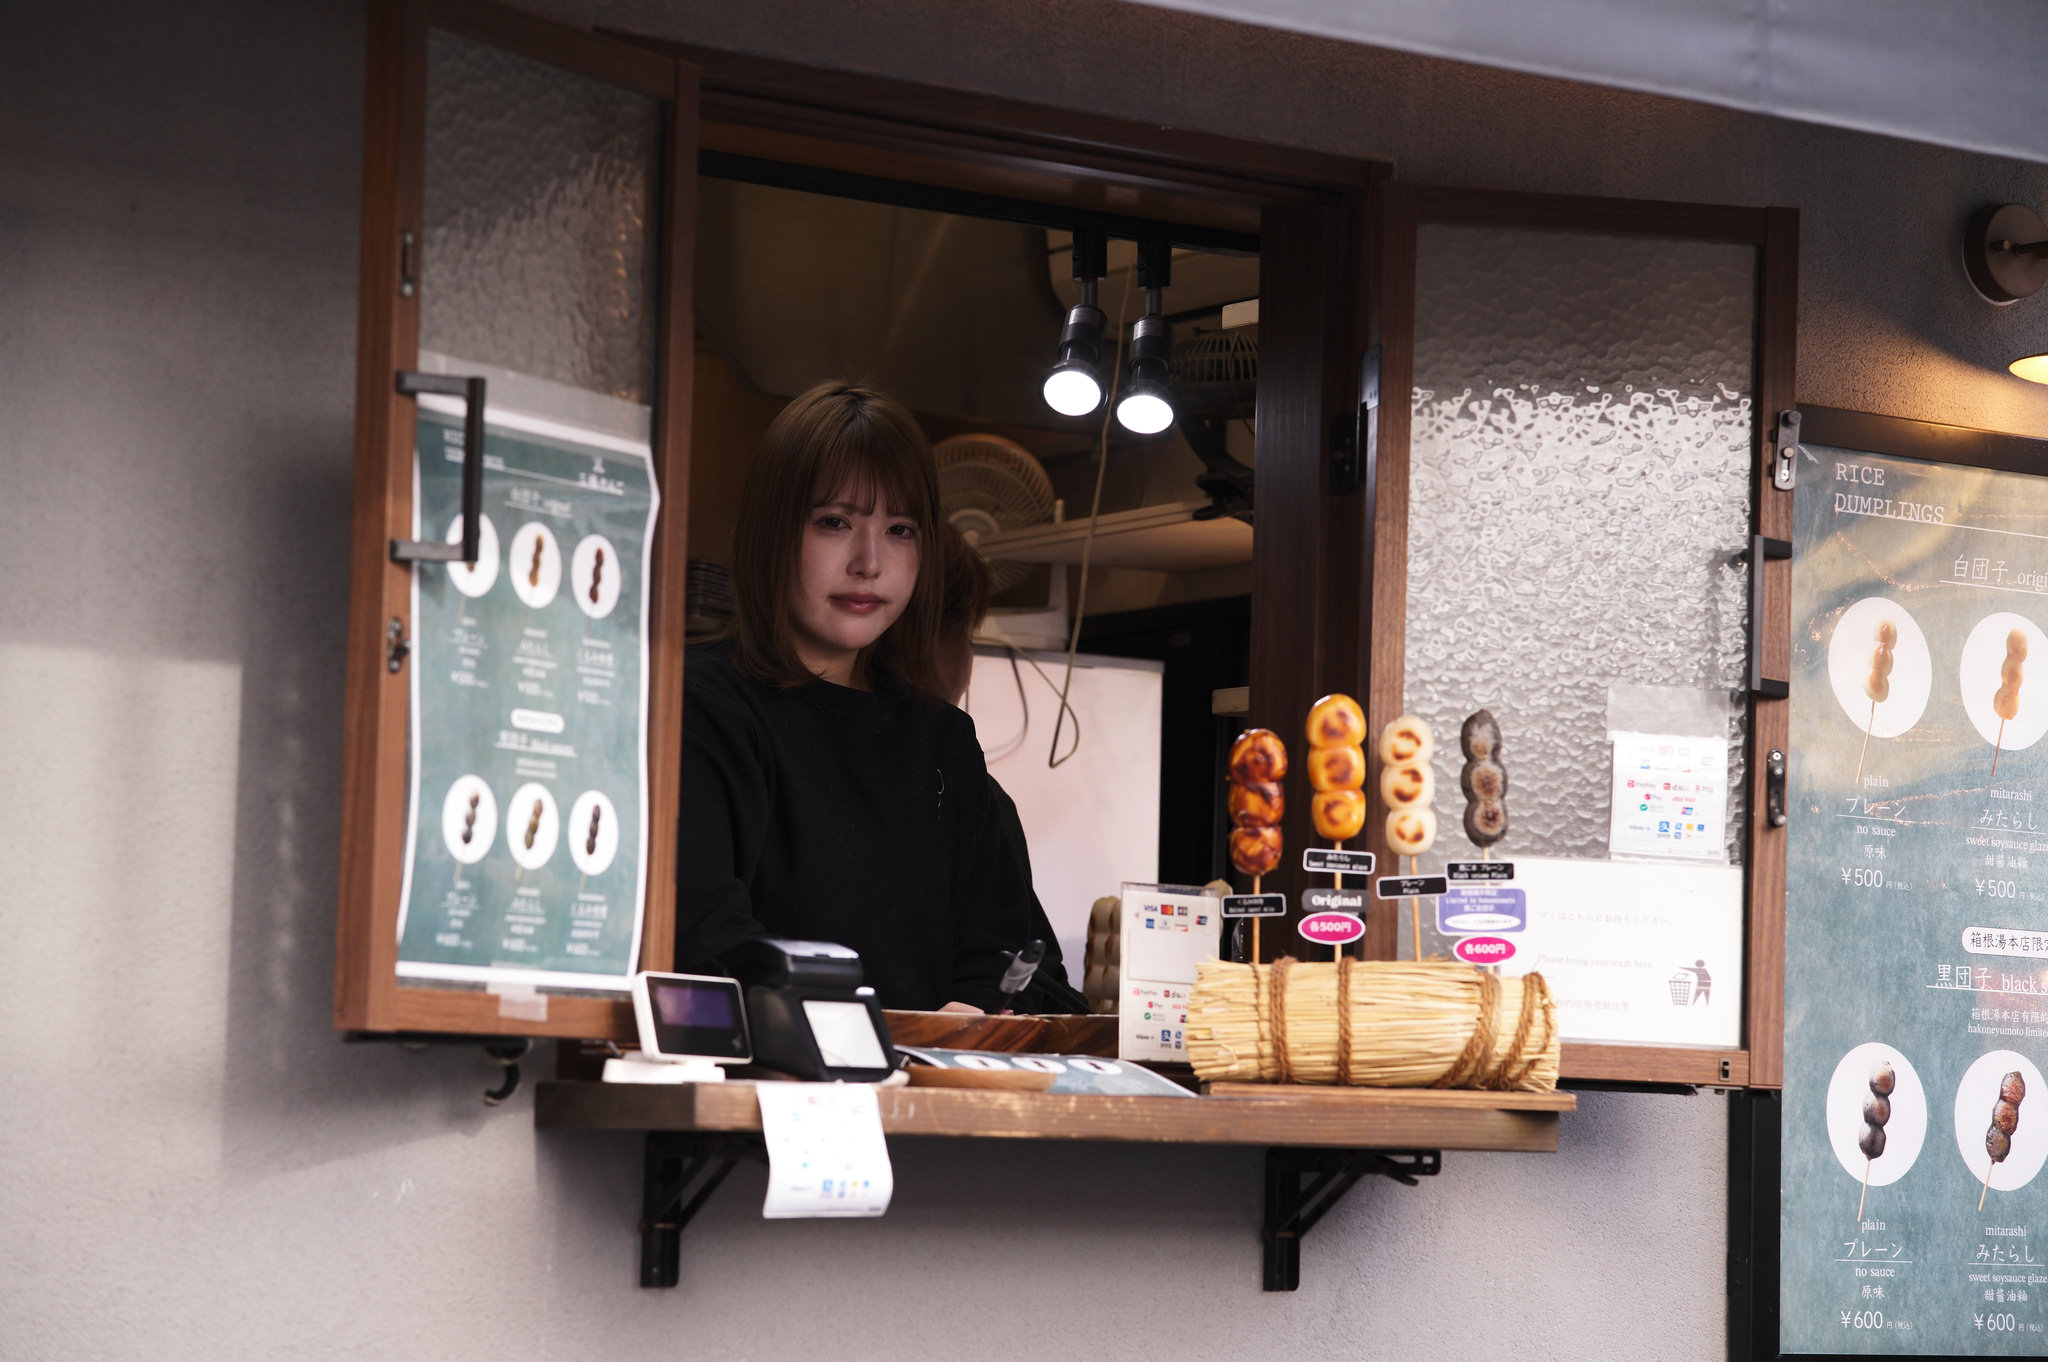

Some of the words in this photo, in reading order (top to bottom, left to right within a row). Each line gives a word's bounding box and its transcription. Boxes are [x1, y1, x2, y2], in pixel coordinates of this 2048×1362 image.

[1835, 463, 1885, 486] RICE
[1834, 493, 1945, 523] DUMPLINGS
[1954, 554, 2008, 583] 白団子
[1863, 775, 1889, 789] plain
[1990, 787, 2033, 802] mitarashi
[1846, 794, 1906, 817] プレーン
[1980, 809, 2038, 831] みたらし
[1856, 825, 1869, 835] no
[1871, 825, 1897, 837] sauce
[1965, 835, 1989, 847] sweet
[1991, 837, 2028, 851] soysauce
[1863, 844, 1887, 860] 原味
[1841, 867, 1883, 888] ¥500
[1975, 878, 2016, 899] ¥500
[1144, 904, 1158, 912] VISA
[1311, 893, 1362, 909] Original
[1309, 921, 1352, 933] 各500円
[1464, 943, 1506, 955] 各600円
[1566, 955, 1589, 967] bring
[1590, 959, 1609, 968] your
[1935, 964, 1992, 990] 黒団子
[2002, 974, 2038, 992] black
[1967, 1022, 2024, 1037] hakoneyumoto
[2025, 1026, 2048, 1038] limite
[1861, 1219, 1886, 1233] plain
[1985, 1225, 2027, 1237] mitarashi
[1844, 1238, 1903, 1258] プレーン
[1976, 1244, 2035, 1263] みたらし
[1855, 1267, 1868, 1277] no
[1870, 1267, 1895, 1277] sauce
[1968, 1273, 1991, 1283] sweet
[1992, 1274, 2026, 1285] soysauce
[2027, 1273, 2048, 1286] glaze
[1861, 1285, 1885, 1300] 原味
[1840, 1310, 1883, 1329] ¥600
[1974, 1313, 2016, 1331] ¥600
